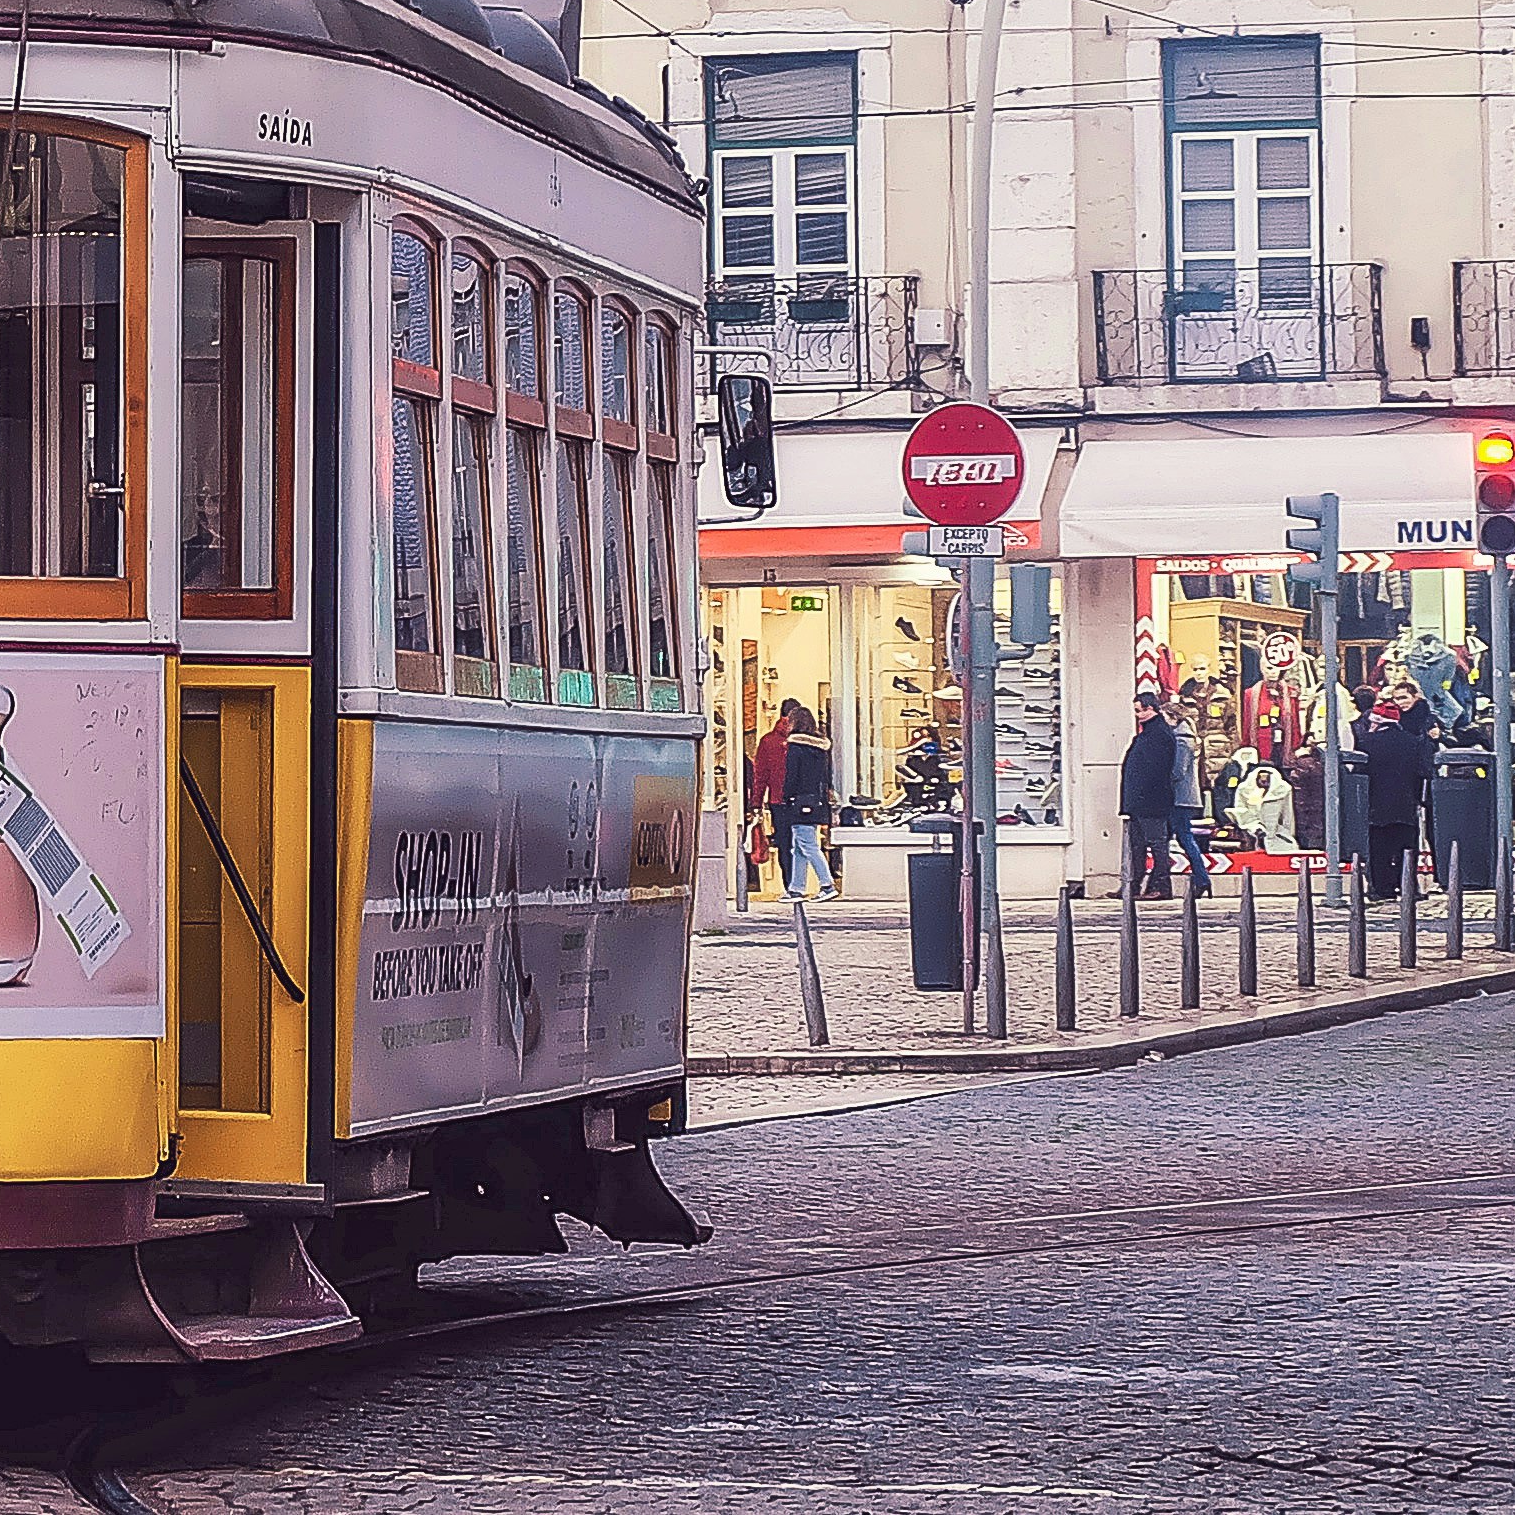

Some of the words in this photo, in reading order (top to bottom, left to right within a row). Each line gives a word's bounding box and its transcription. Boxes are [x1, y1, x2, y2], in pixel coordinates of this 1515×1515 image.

[258, 108, 313, 147] SAÍDA
[944, 528, 989, 543] EXCEPTO
[391, 830, 483, 933] SHOP-IN
[371, 947, 415, 1001] BEFORE
[415, 945, 437, 997] YOU
[438, 943, 464, 994] TAKE
[464, 942, 484, 990] OFF
